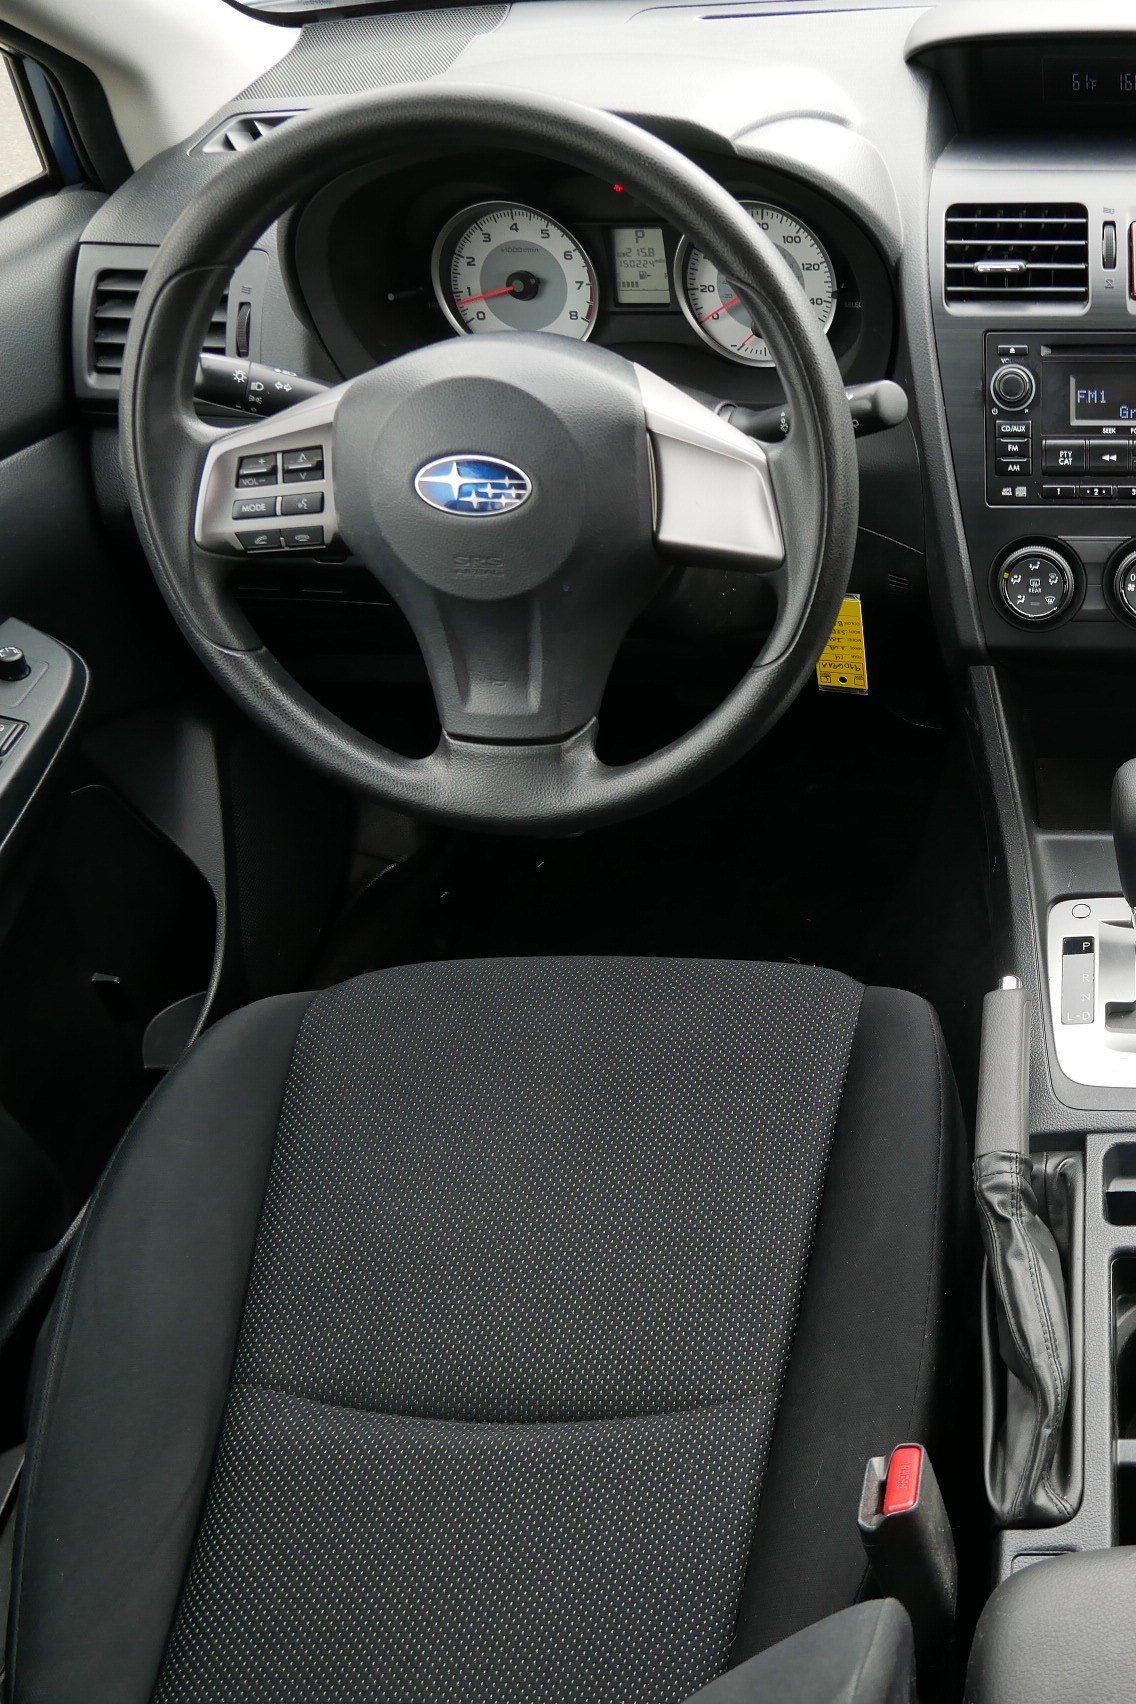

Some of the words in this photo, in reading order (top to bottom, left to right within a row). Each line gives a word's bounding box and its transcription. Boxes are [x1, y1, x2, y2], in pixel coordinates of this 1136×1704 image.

[510, 222, 519, 232] 4
[482, 233, 491, 243] 3
[541, 229, 550, 239] 5
[635, 230, 646, 243] P
[782, 235, 802, 244] 100
[563, 251, 573, 260] 6
[466, 257, 476, 267] 2
[802, 262, 821, 271] 120
[575, 281, 584, 291] 7
[699, 284, 715, 293] 20
[477, 311, 486, 320] 0
[569, 311, 579, 320] 8
[1077, 390, 1107, 404] FM1
[1001, 425, 1026, 433] CD/AUX
[1058, 458, 1073, 466] CAT
[242, 478, 259, 486] VOL
[241, 503, 267, 513] MODE
[1130, 574, 1136, 582] 0
[1082, 942, 1091, 950] P
[1082, 974, 1090, 982] R
[1082, 993, 1091, 1001] N
